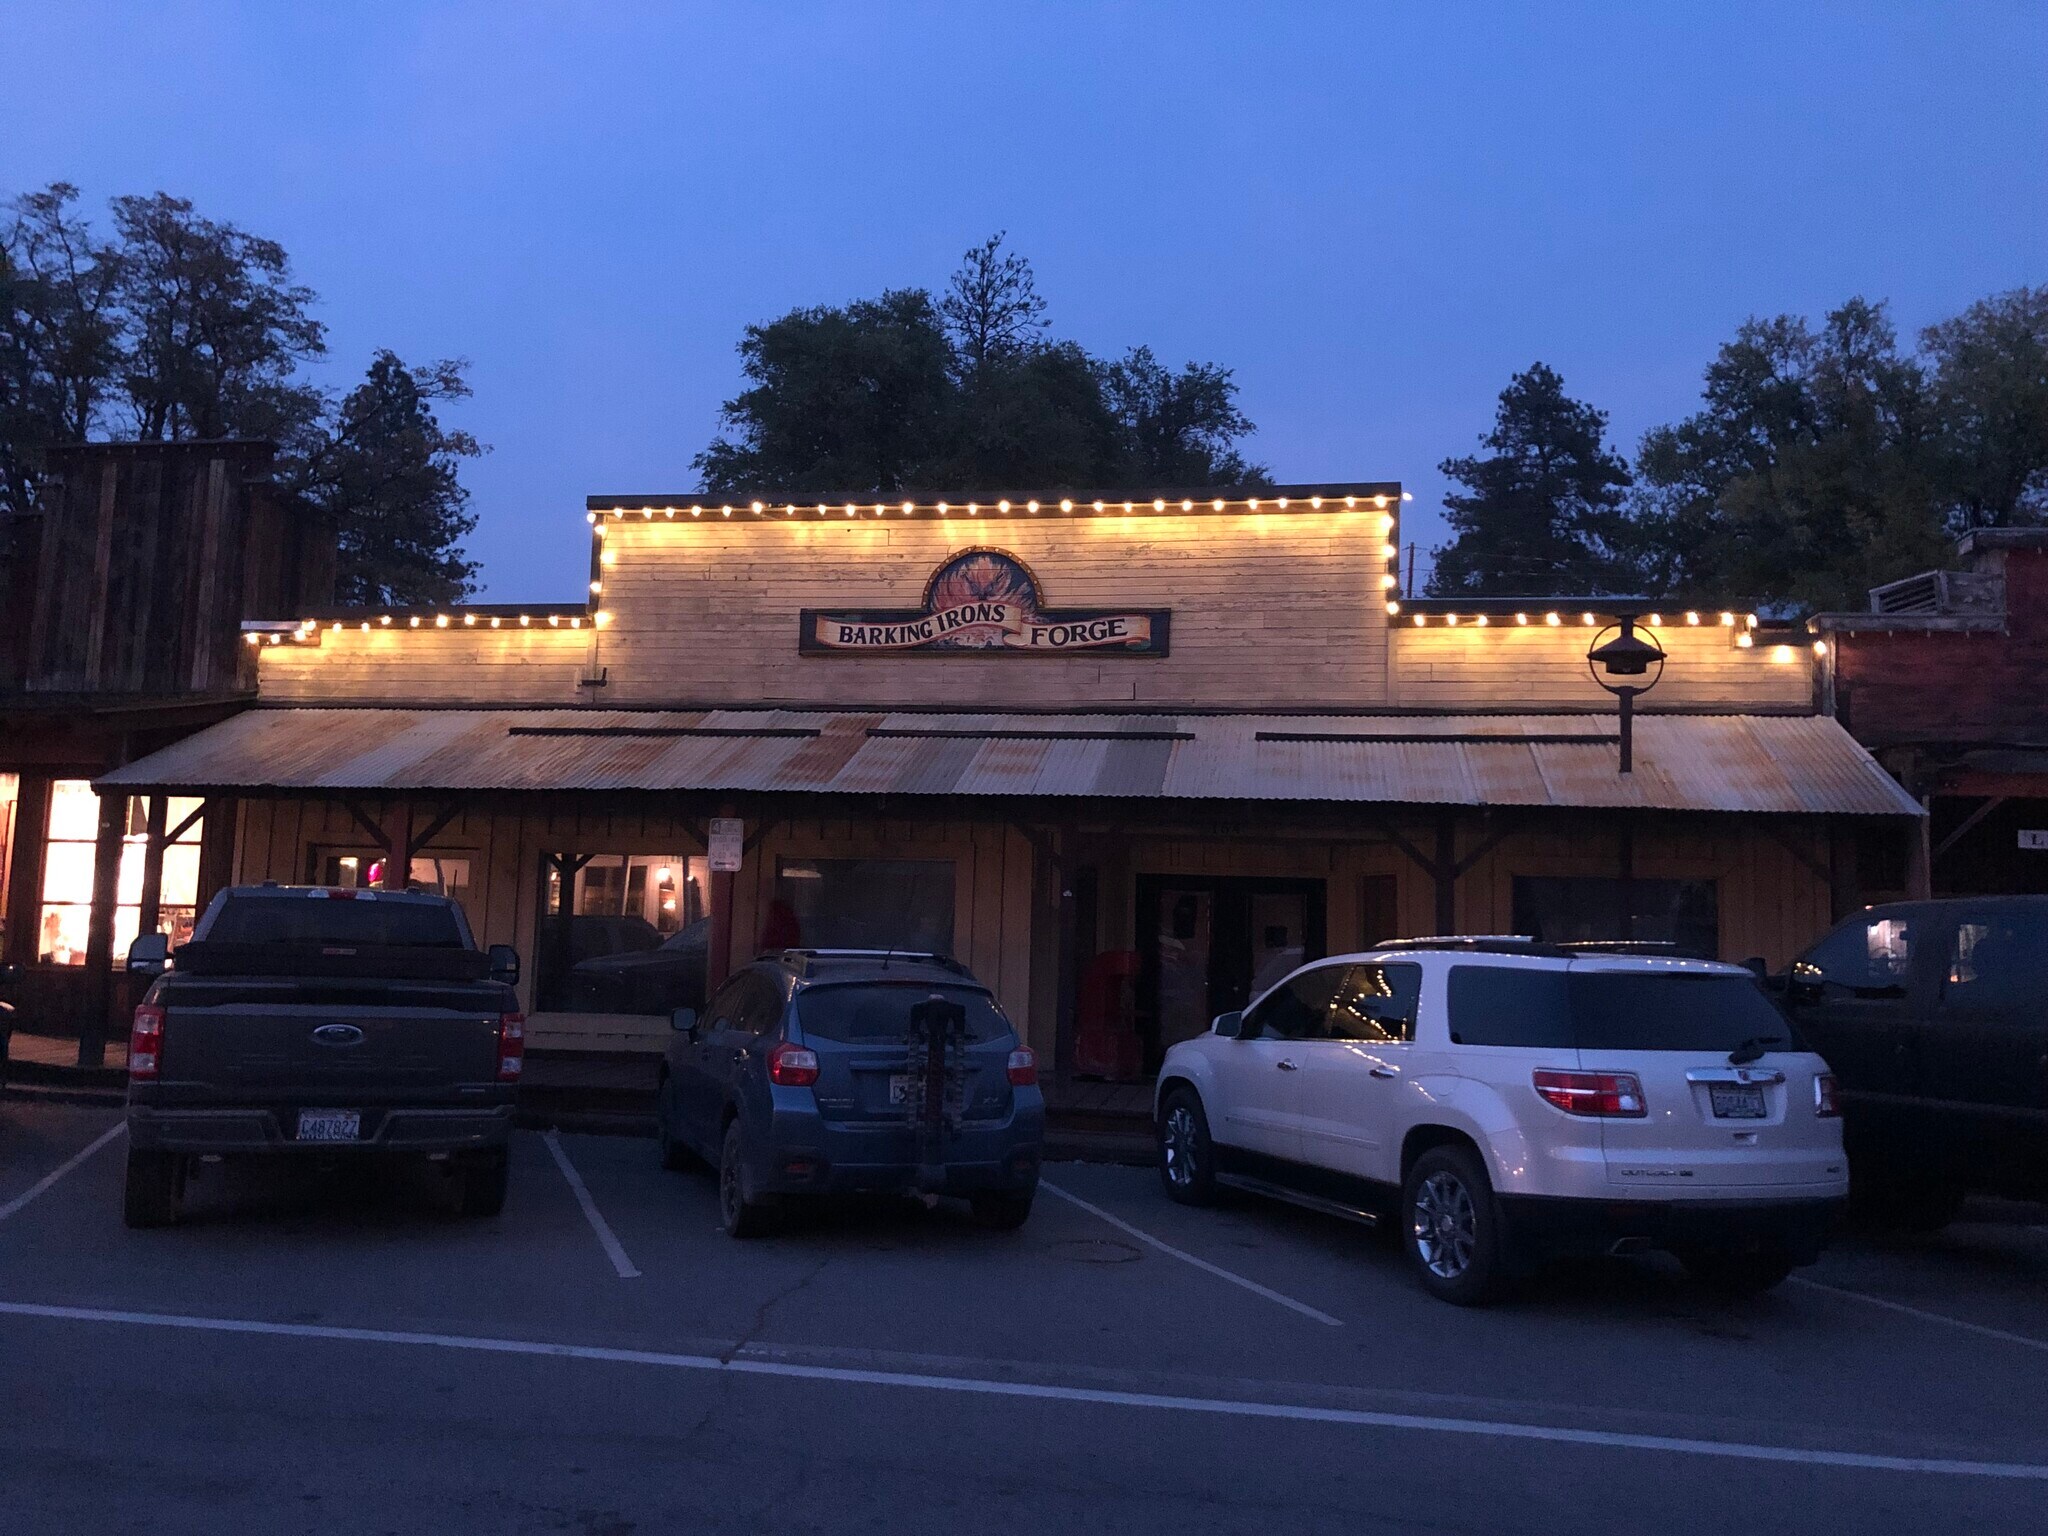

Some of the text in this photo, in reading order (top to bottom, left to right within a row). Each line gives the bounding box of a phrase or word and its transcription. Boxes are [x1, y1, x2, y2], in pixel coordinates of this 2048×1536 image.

[839, 604, 1006, 644] BARKING IRONS
[1030, 618, 1129, 646] FORGE
